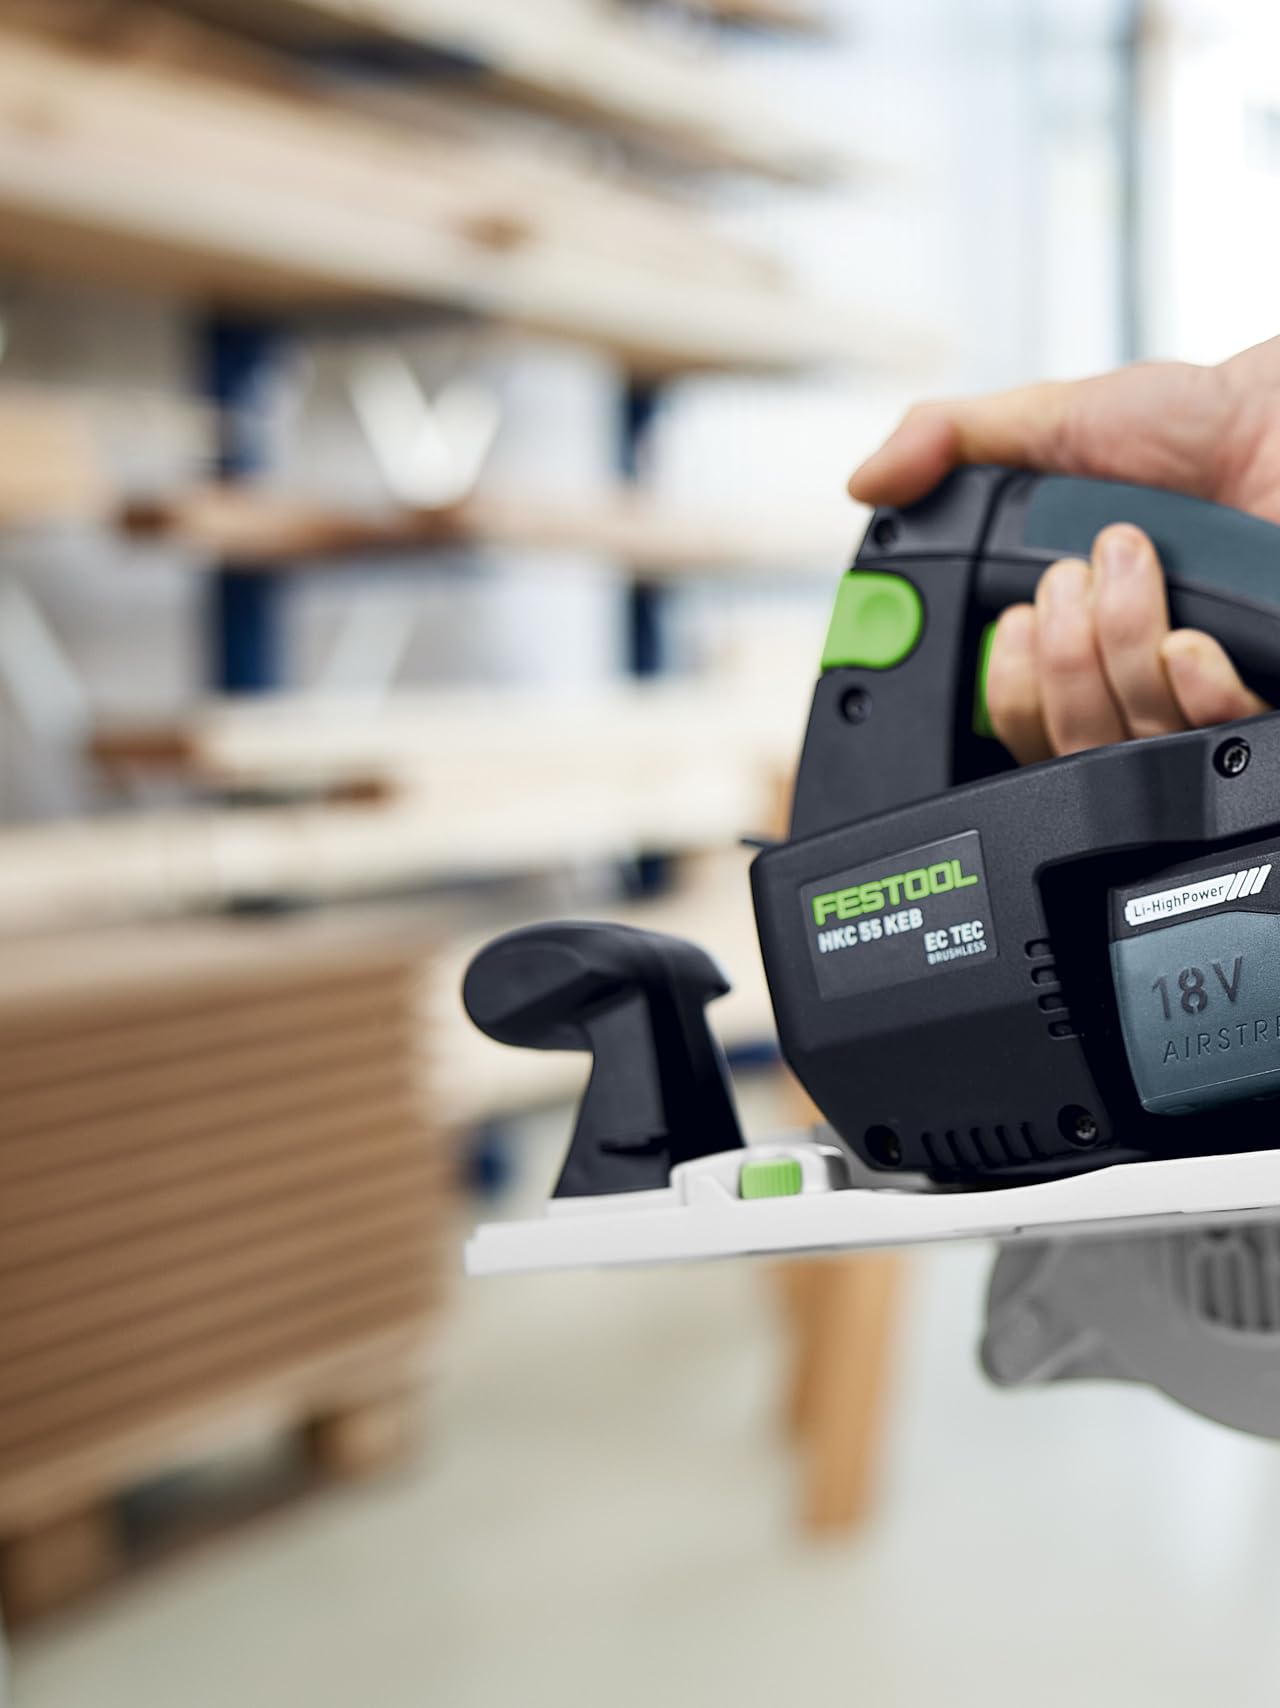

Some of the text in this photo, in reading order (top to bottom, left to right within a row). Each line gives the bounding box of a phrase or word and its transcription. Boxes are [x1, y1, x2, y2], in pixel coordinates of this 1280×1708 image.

[812, 859, 978, 926] FESTOOL
[1134, 885, 1224, 917] Li-HighPower
[817, 908, 923, 953] HKC 55 KEB
[924, 920, 985, 952] EC TEC
[927, 940, 987, 965] BRUSHLESS
[1152, 956, 1243, 1020] 18V
